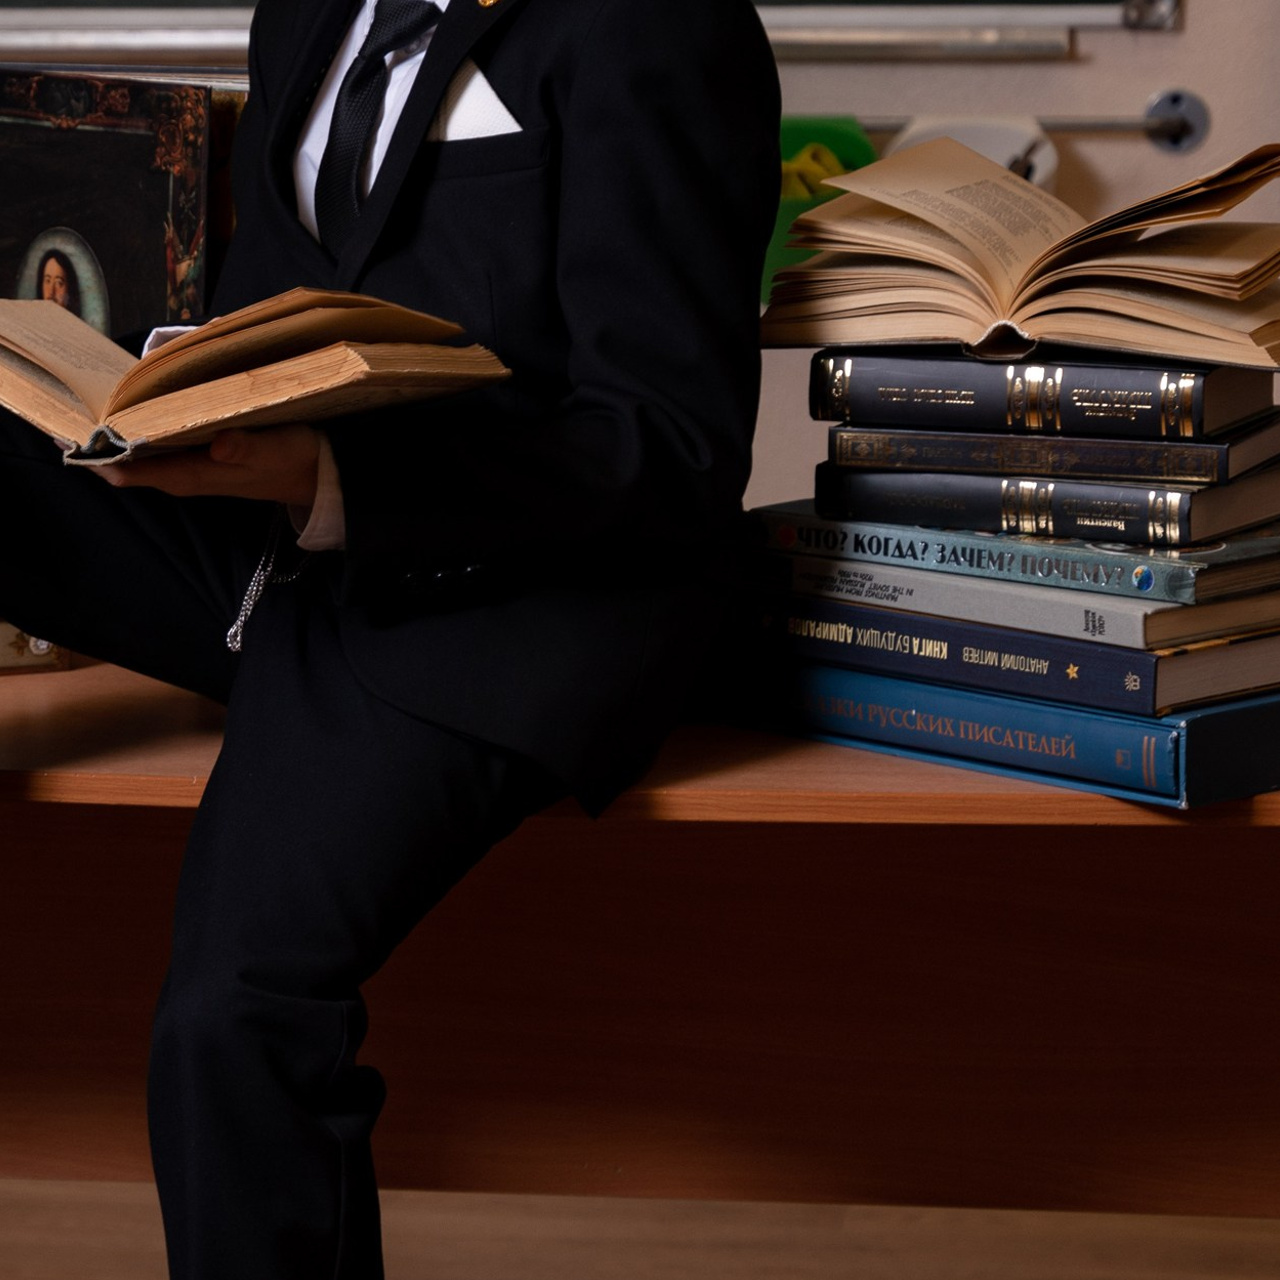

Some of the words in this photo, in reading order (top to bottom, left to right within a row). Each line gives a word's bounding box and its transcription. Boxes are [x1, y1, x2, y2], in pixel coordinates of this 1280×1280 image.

[853, 534, 929, 562] КОГДА?
[934, 544, 1015, 573] ЗАЧЕМ?
[1021, 556, 1125, 587] ПОЧЕМУ?
[854, 627, 910, 653] БУДУЩИХ
[912, 636, 949, 660] КНИГА
[962, 646, 999, 667] МИТЯЕВ
[1000, 652, 1049, 675] АНАТОЛИЙ
[867, 704, 956, 738] РУССКИХ
[959, 720, 1077, 760] ПИСАТЕЛЕЙ
